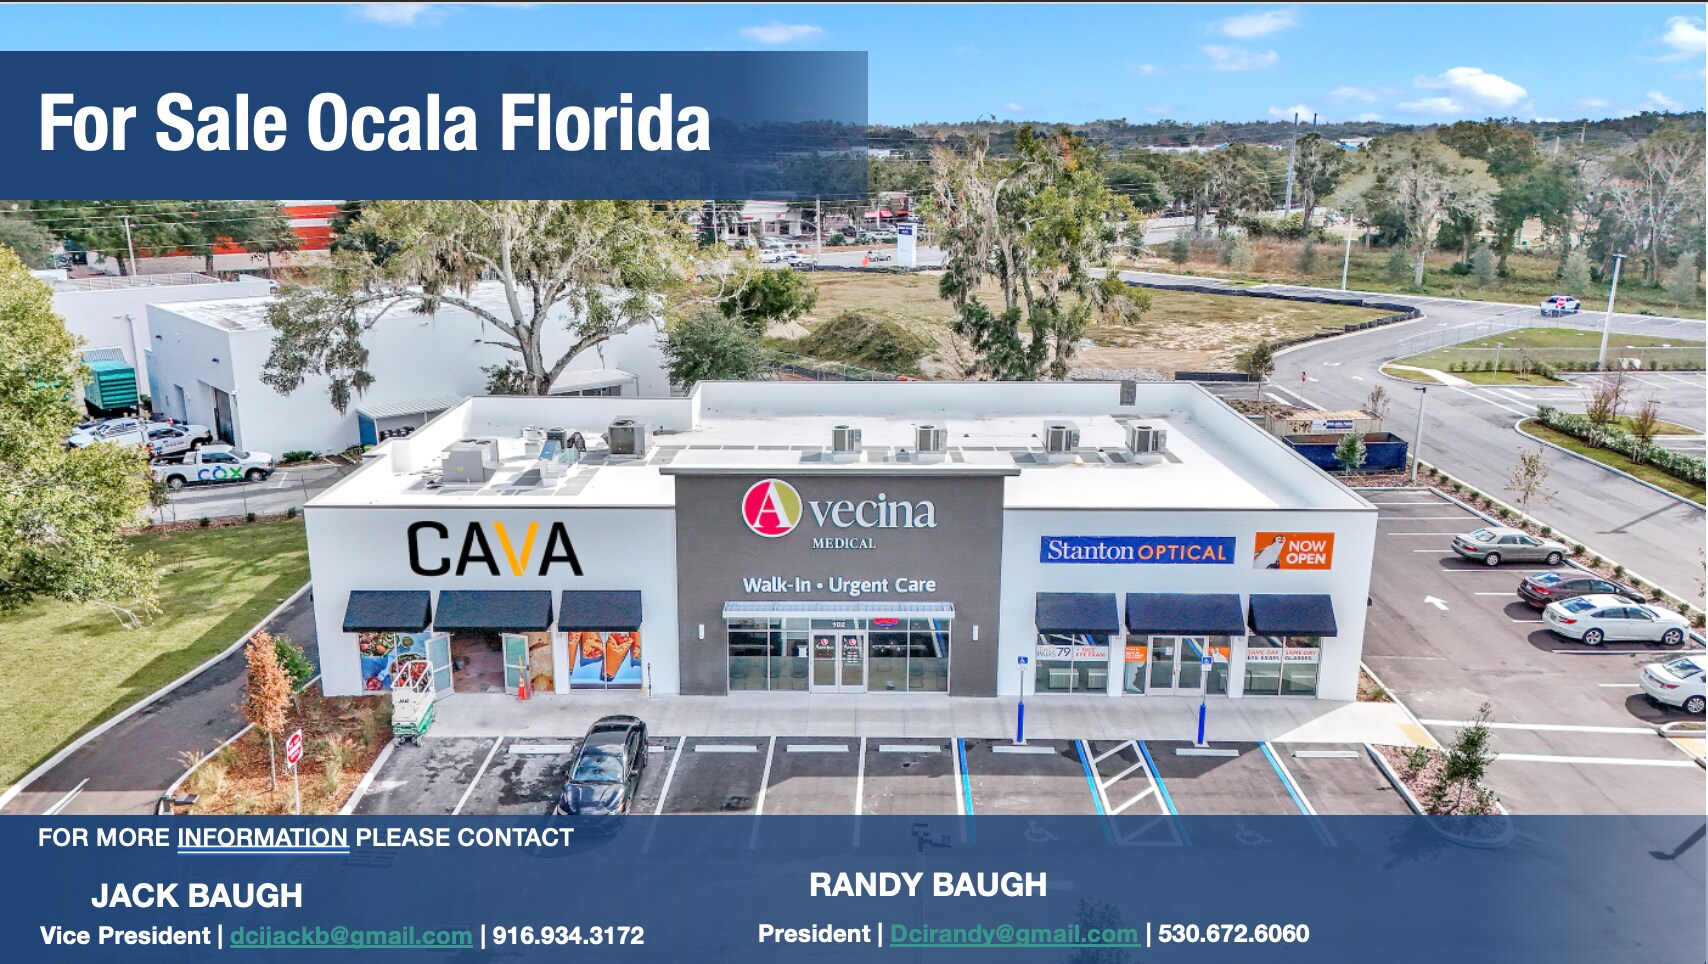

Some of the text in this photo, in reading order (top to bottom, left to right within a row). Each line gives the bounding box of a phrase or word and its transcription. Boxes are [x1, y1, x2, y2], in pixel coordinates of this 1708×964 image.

[407, 520, 584, 577] CAVA
[812, 537, 877, 549] MEDICAL
[1288, 540, 1328, 553] NOW
[1047, 539, 1227, 562] Stanton OPTICAL
[1286, 553, 1327, 565] OPEN
[743, 576, 937, 597] Walk-In Urgent Care
[1056, 646, 1072, 657] 79
